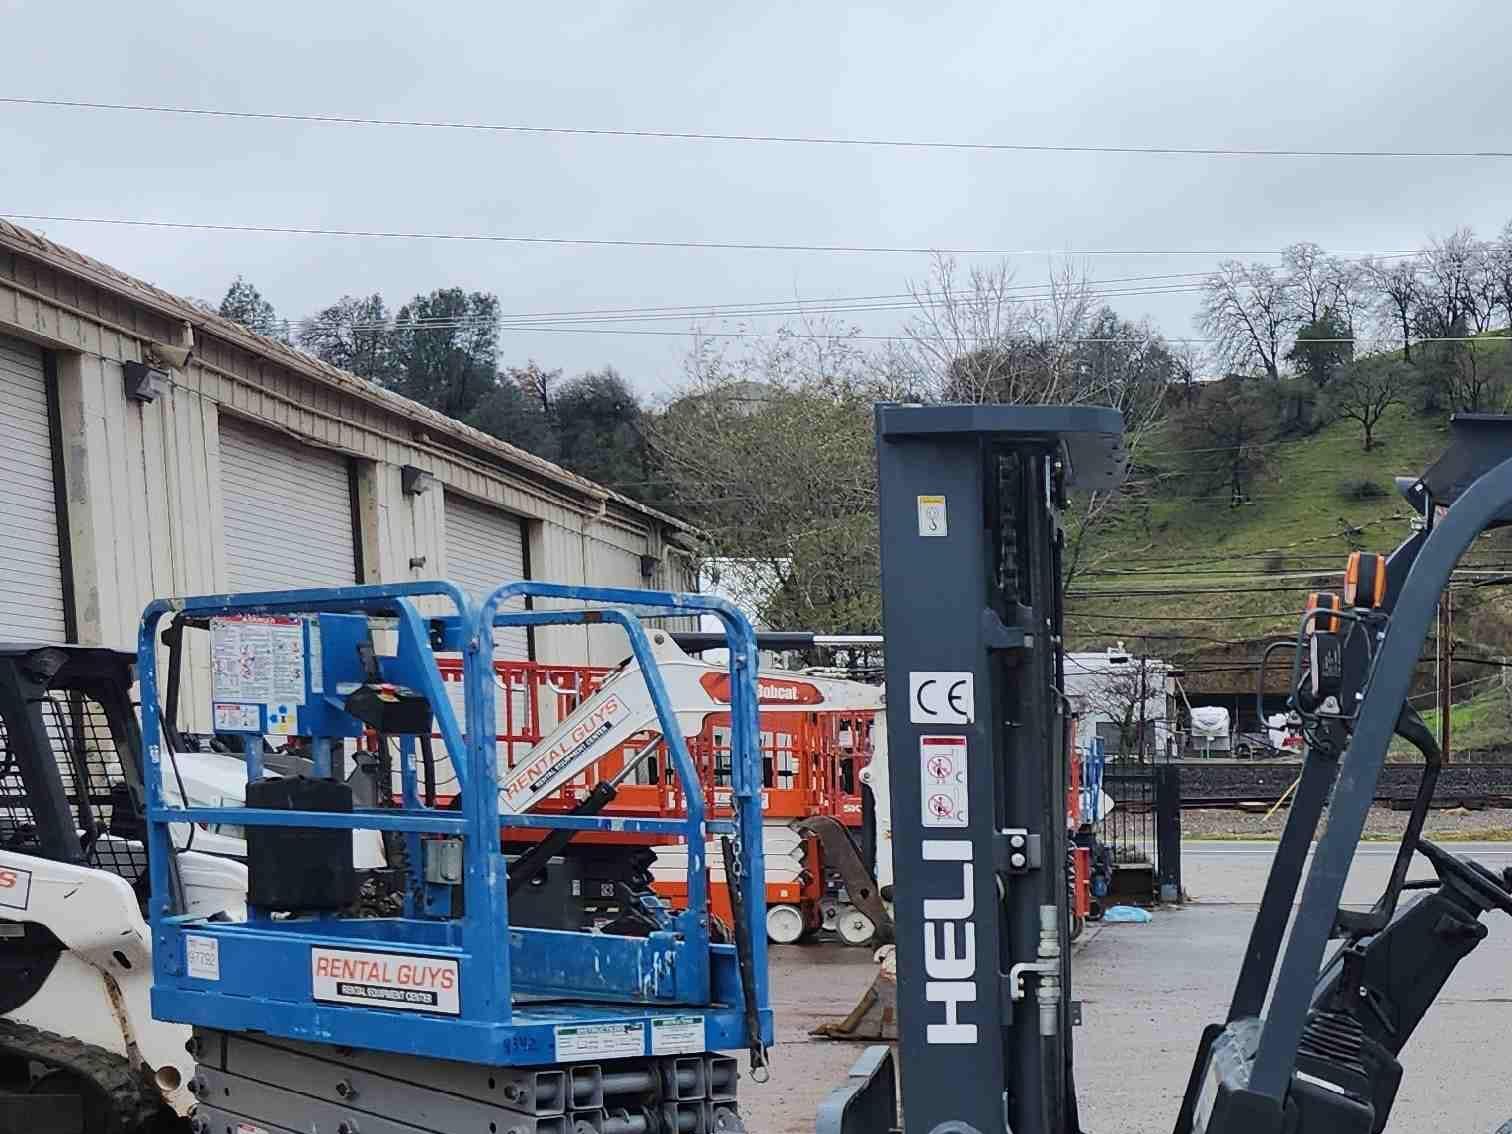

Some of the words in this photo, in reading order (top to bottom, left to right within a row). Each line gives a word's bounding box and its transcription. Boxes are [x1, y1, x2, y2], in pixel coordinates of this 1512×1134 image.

[506, 742, 572, 800] RENTAL
[571, 698, 619, 743] GUYS
[316, 957, 392, 983] RENTAL
[397, 965, 455, 989] GUYS
[922, 840, 977, 1044] HELI
